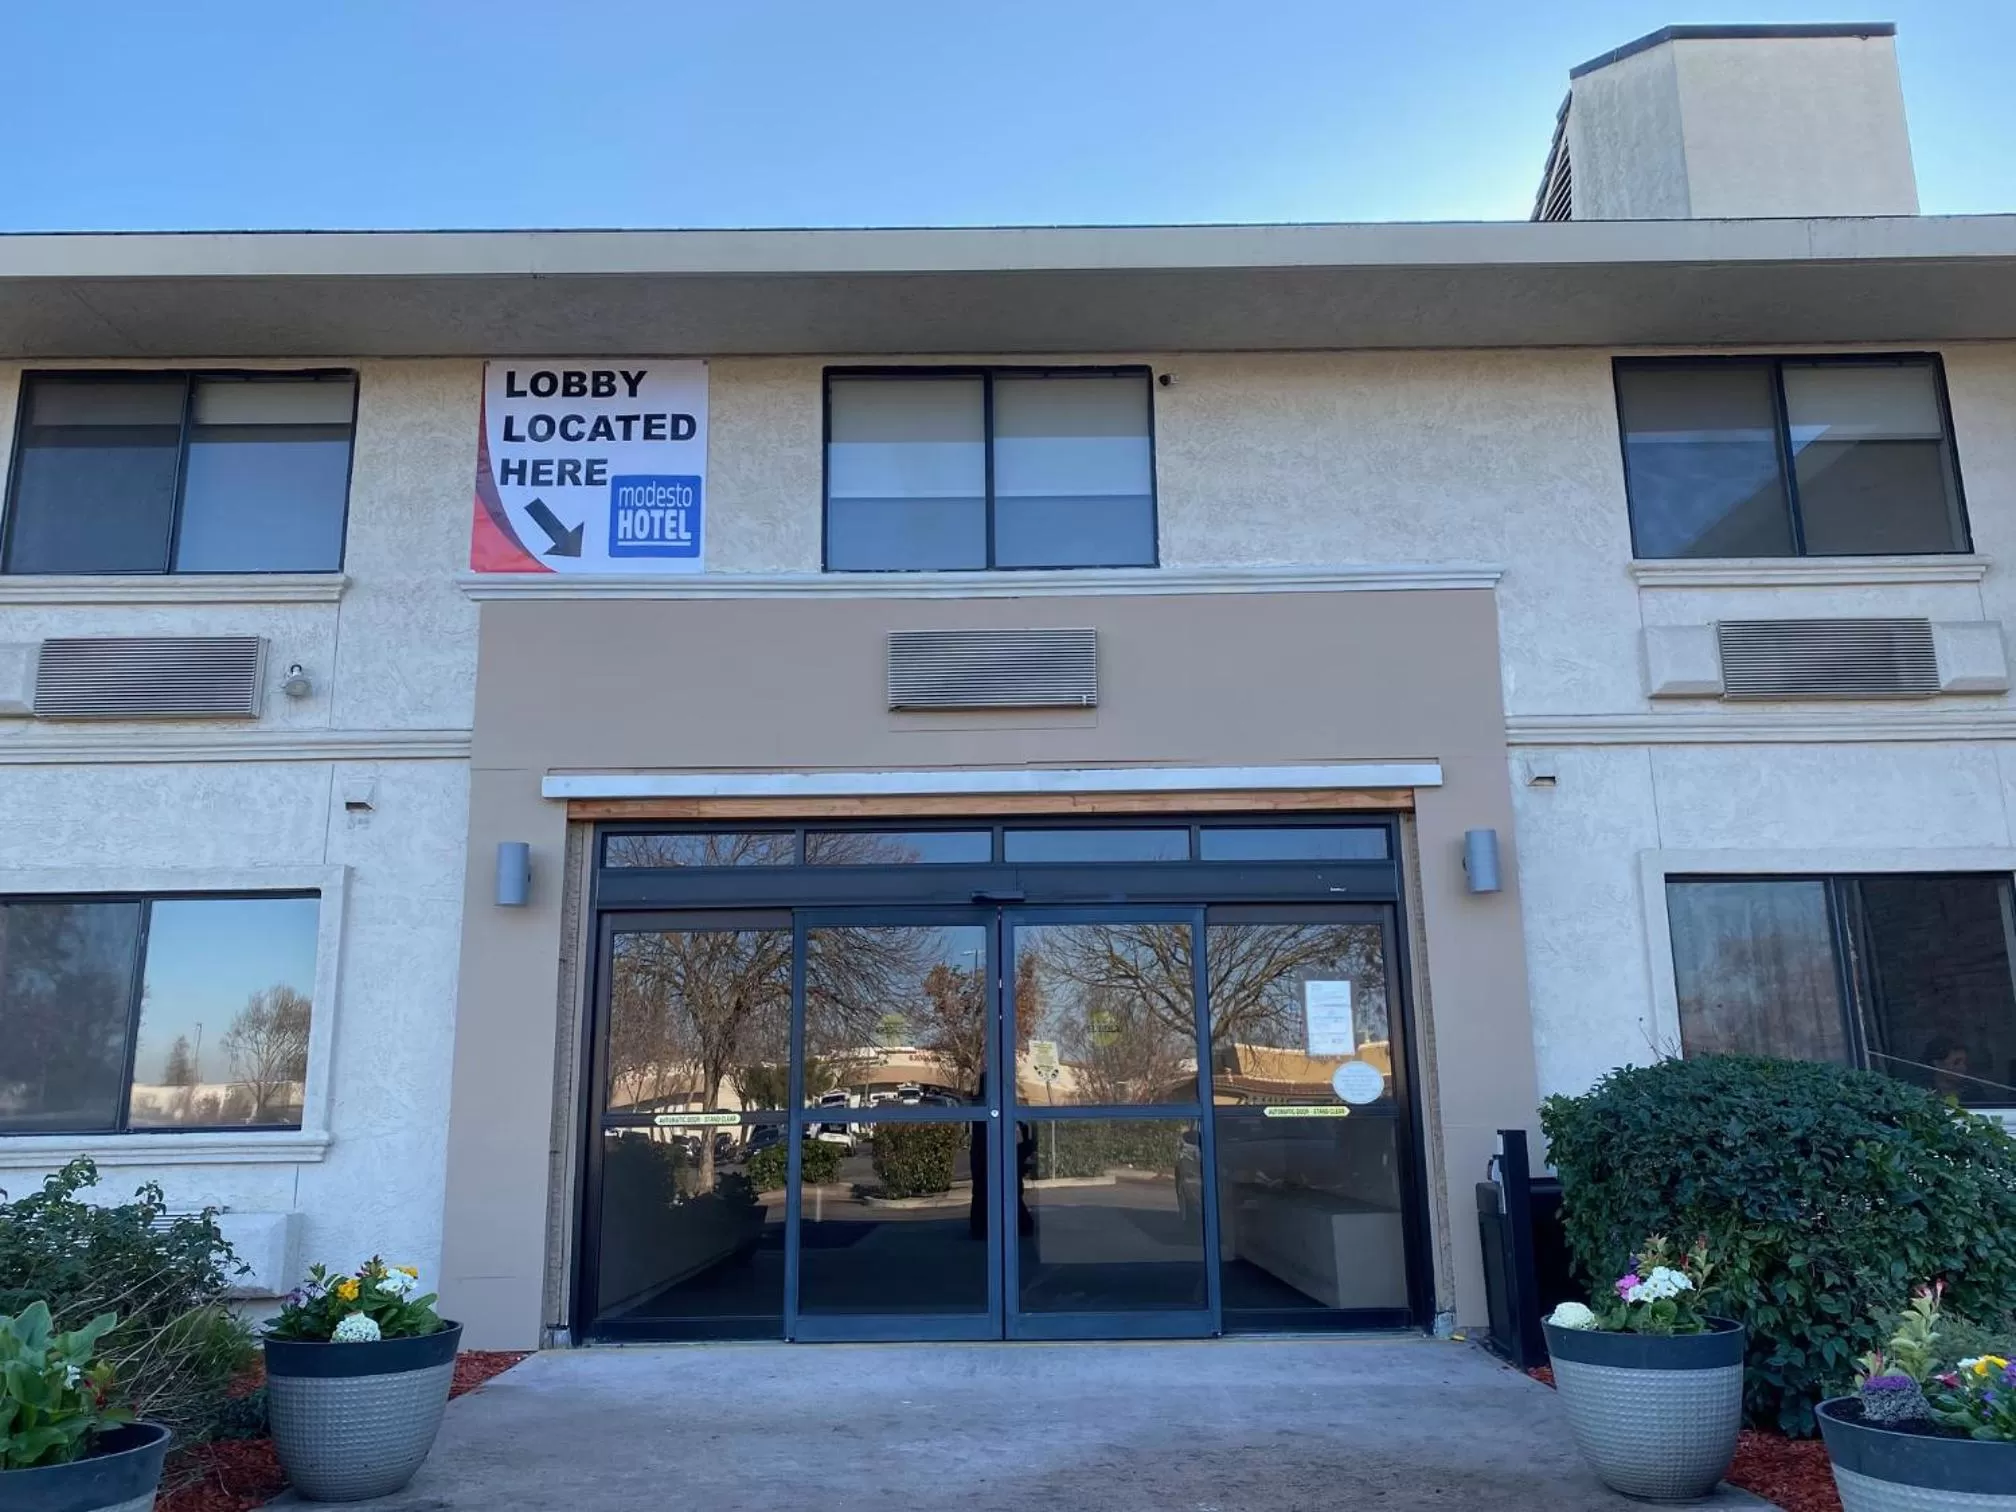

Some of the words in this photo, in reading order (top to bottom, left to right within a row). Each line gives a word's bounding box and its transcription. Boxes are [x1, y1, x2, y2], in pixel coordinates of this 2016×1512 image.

[506, 370, 648, 398] LOBBY
[503, 413, 697, 443] LOCATED
[500, 458, 608, 487] HERE
[618, 480, 693, 508] modesto
[617, 508, 692, 540] HOTEL
